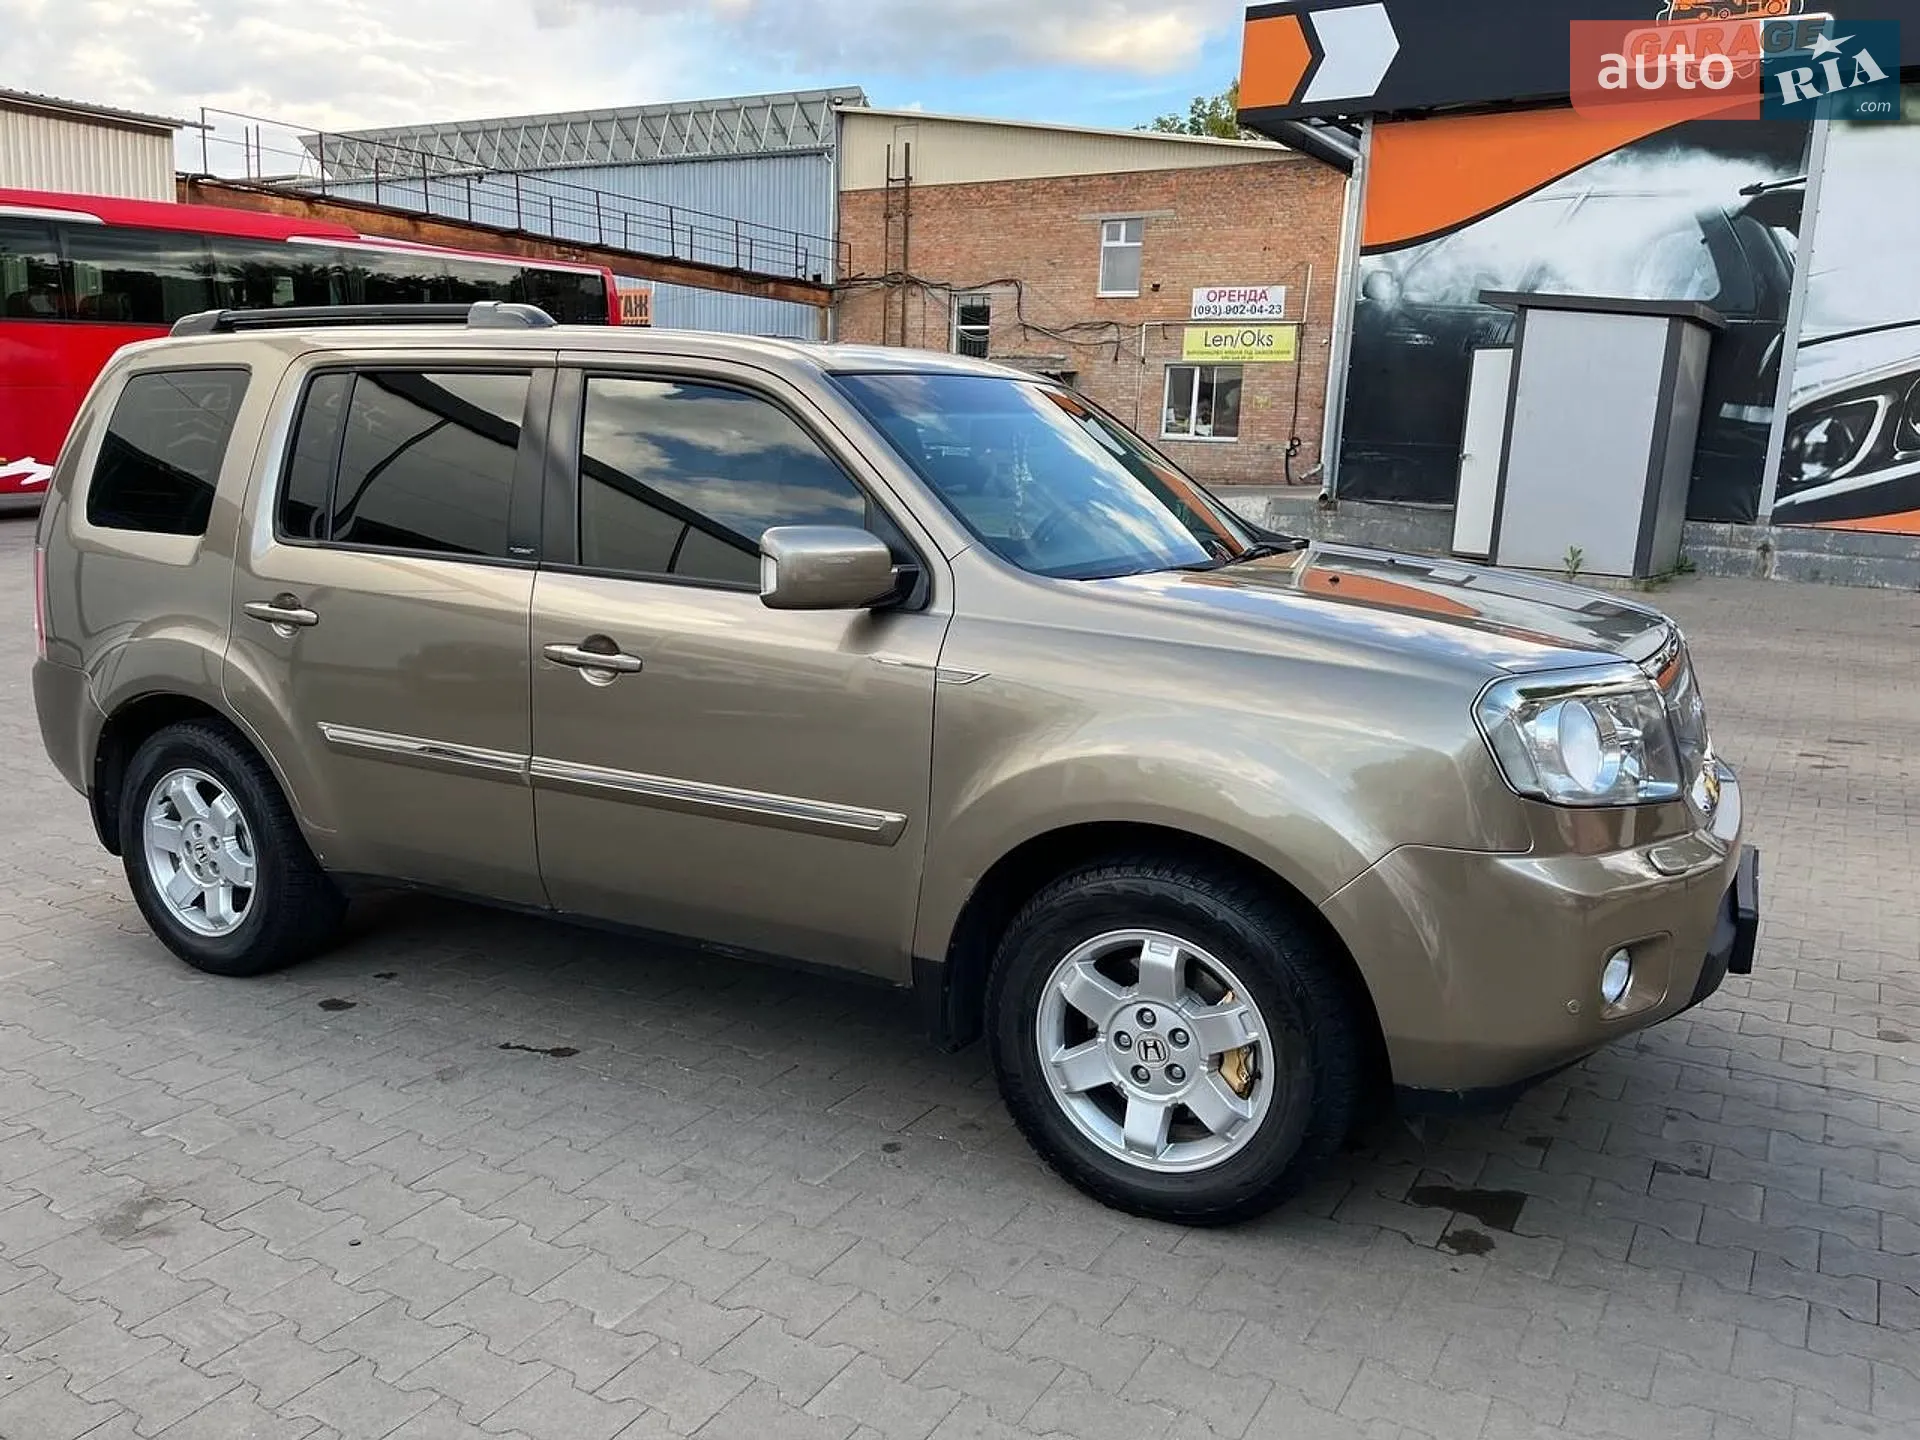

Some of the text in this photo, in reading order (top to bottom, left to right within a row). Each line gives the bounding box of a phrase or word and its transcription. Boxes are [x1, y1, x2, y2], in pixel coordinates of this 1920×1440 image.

[1630, 18, 1826, 64] GARAGE
[1206, 289, 1269, 304] ОРЕНДА
[1204, 329, 1273, 348] Len/Oks
